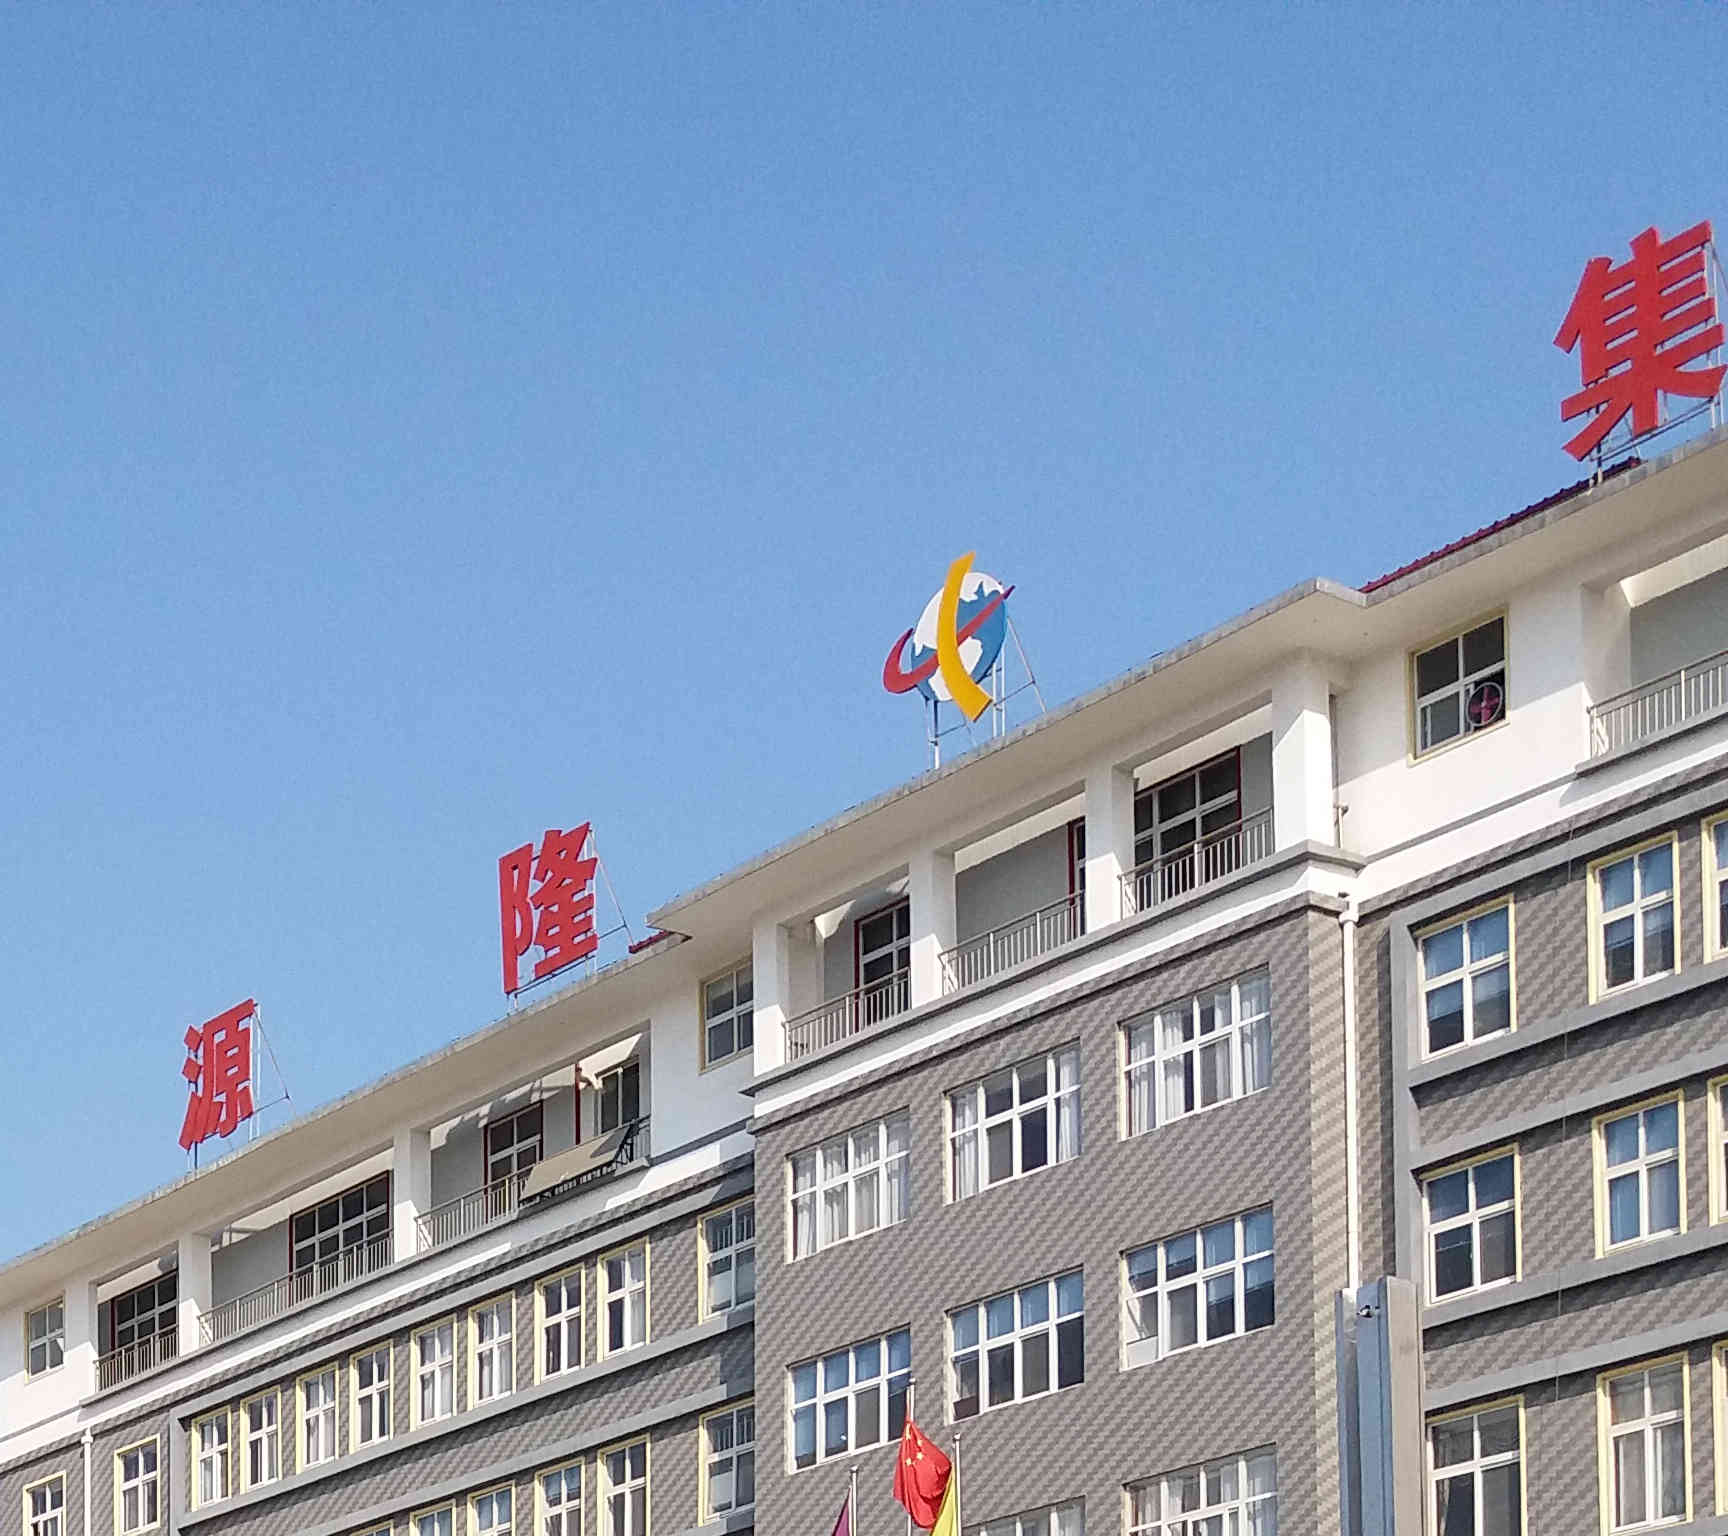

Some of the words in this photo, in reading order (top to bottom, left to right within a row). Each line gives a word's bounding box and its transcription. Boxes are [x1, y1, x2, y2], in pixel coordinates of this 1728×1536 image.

[179, 998, 255, 1150] 源
[499, 822, 598, 993] 隆
[1554, 220, 1726, 461] 集
